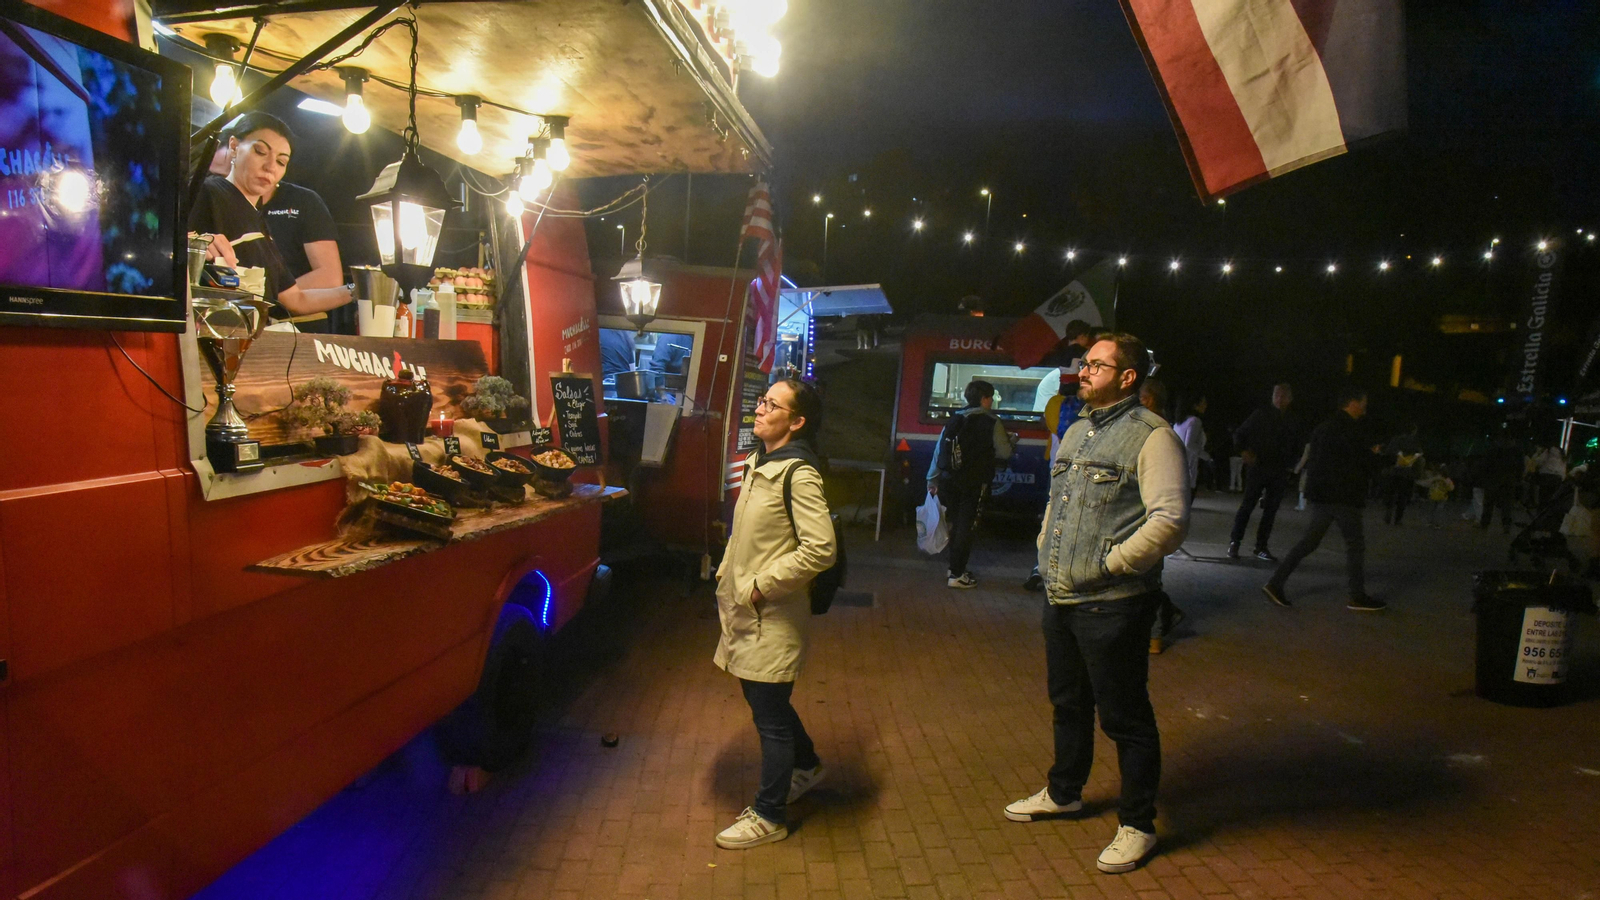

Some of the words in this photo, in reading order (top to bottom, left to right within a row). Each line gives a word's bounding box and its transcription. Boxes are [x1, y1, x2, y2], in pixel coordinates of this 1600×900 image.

[1527, 272, 1553, 330] Galicia
[1516, 331, 1542, 393] Estrella
[555, 381, 582, 400] Salsas
[1526, 628, 1547, 636] ENTRE
[1523, 646, 1546, 658] 956
